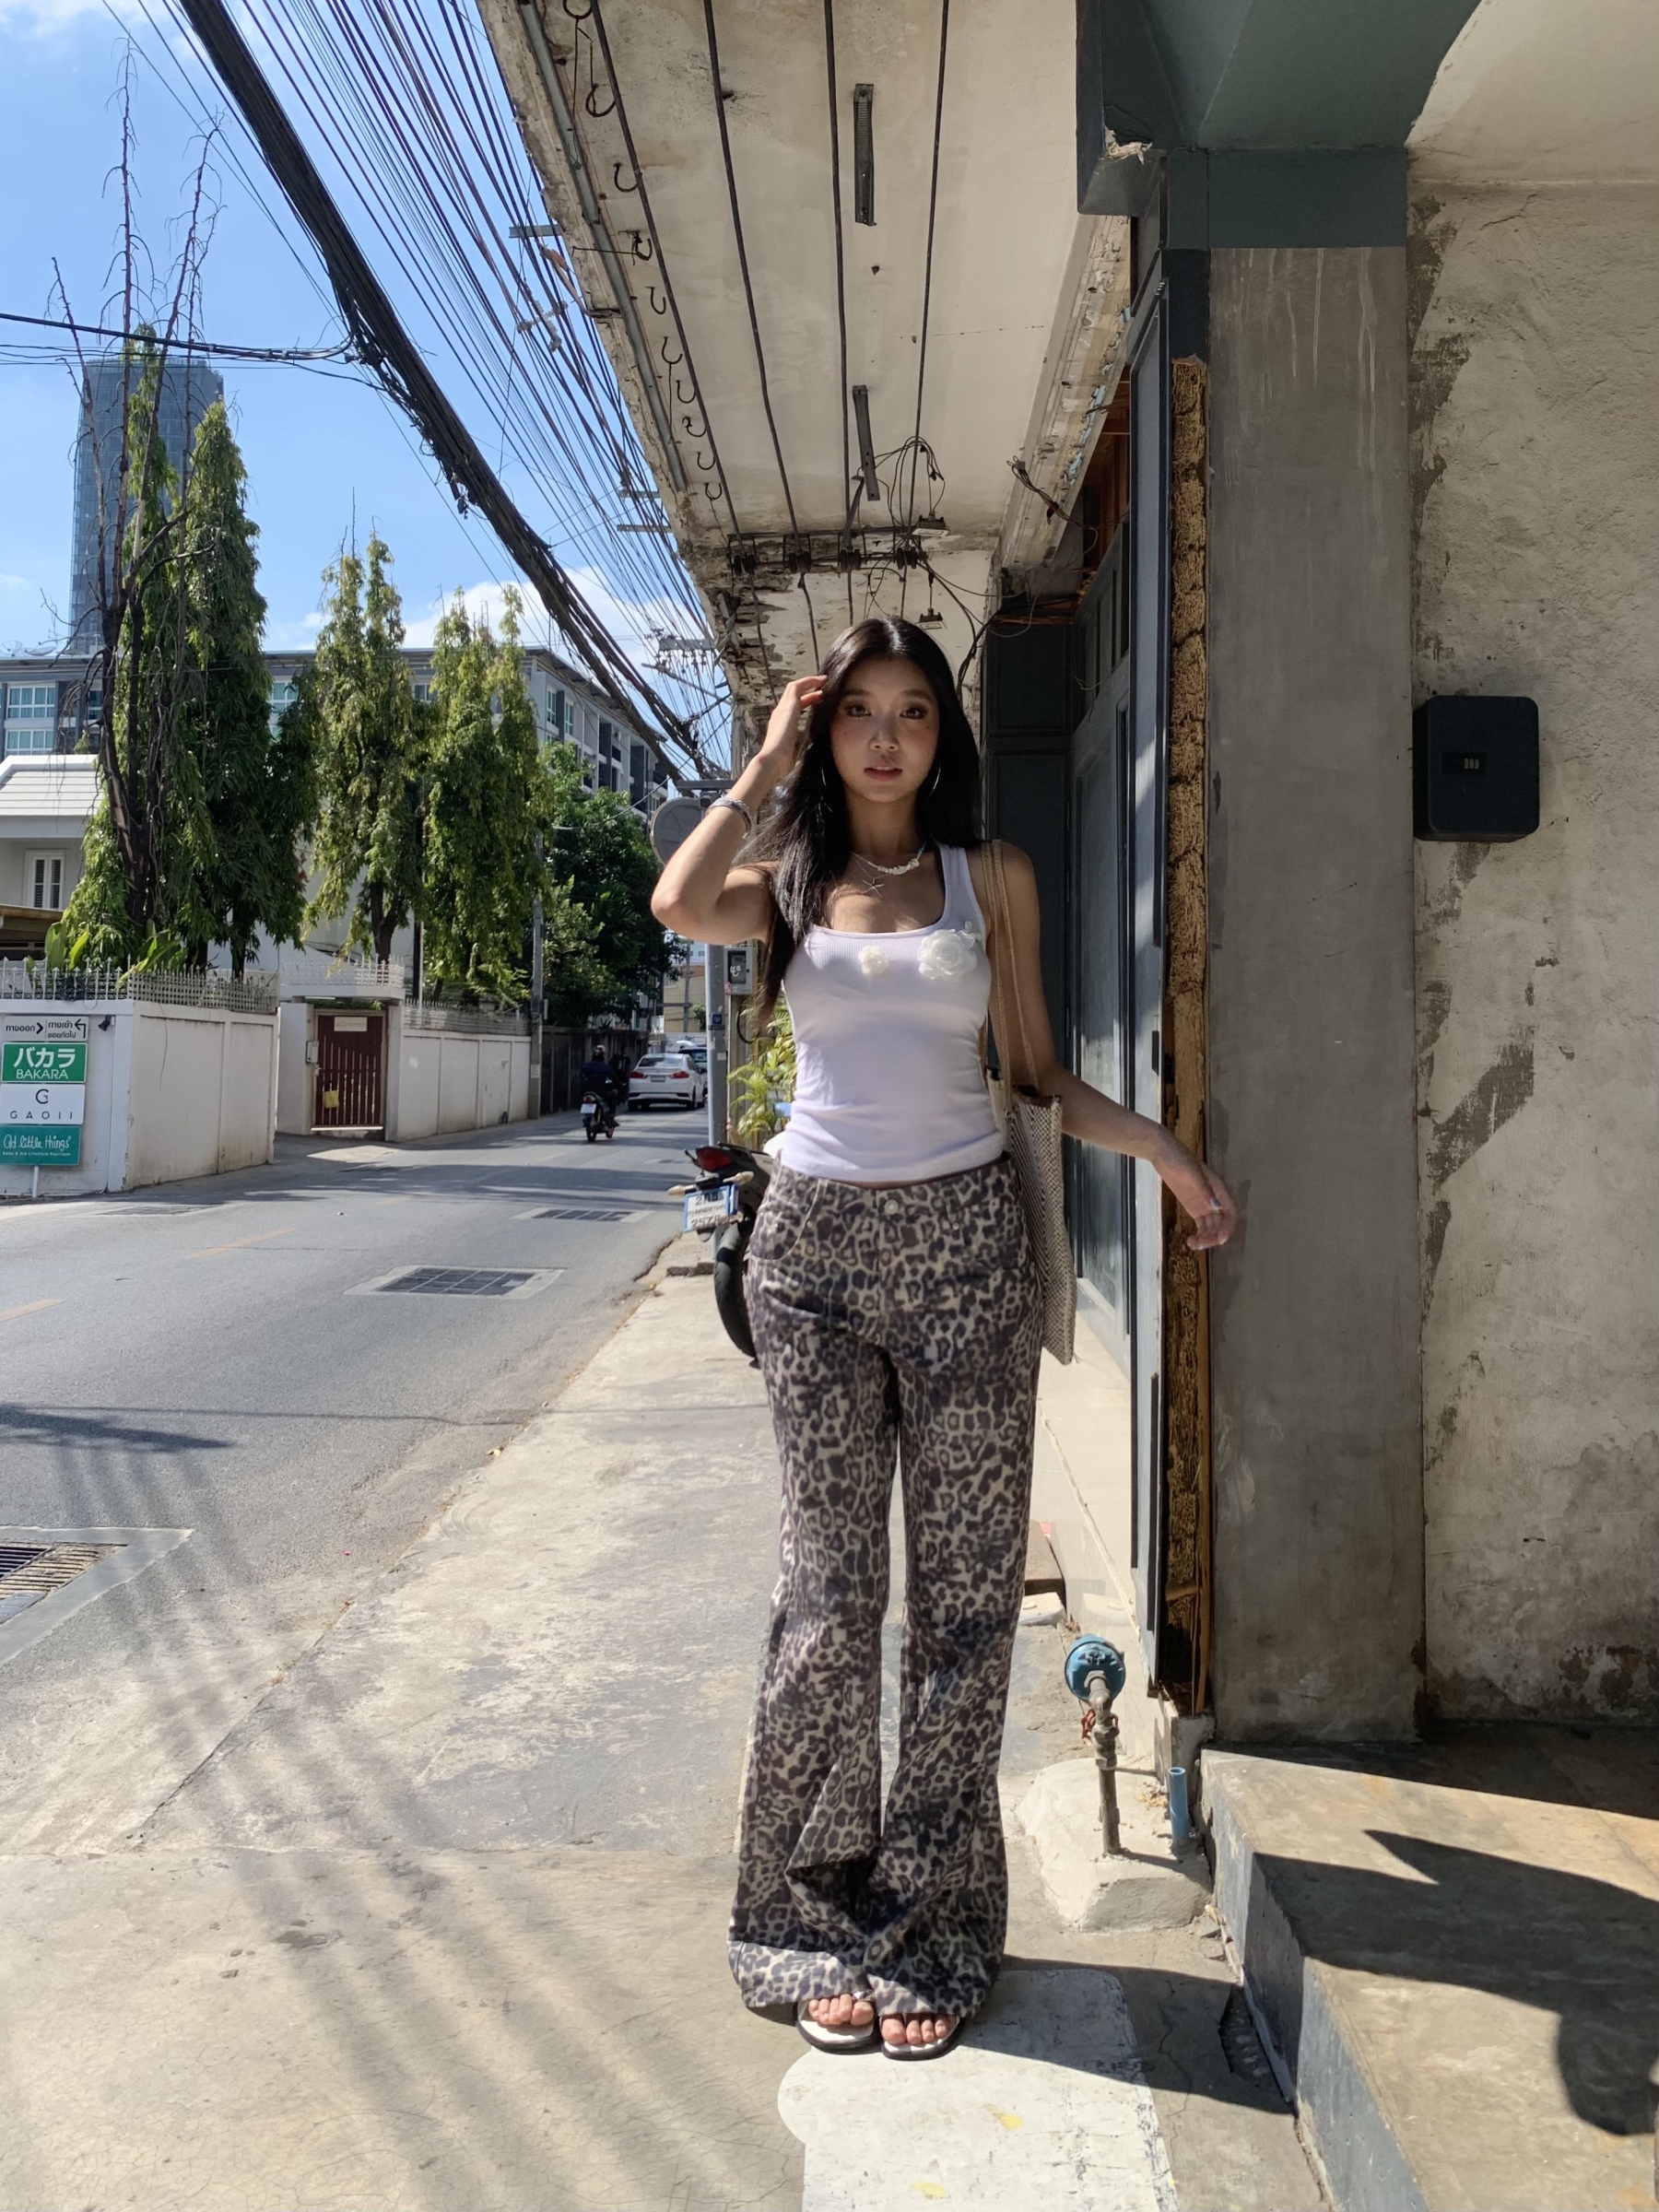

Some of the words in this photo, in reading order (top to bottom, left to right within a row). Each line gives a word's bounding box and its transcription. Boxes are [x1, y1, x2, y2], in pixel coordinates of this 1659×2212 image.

[48, 1020, 73, 1029] ทางเข้า
[13, 1046, 76, 1068] バカラ
[16, 1069, 68, 1079] BAKARA
[35, 1088, 49, 1104] G
[18, 1135, 43, 1148] little
